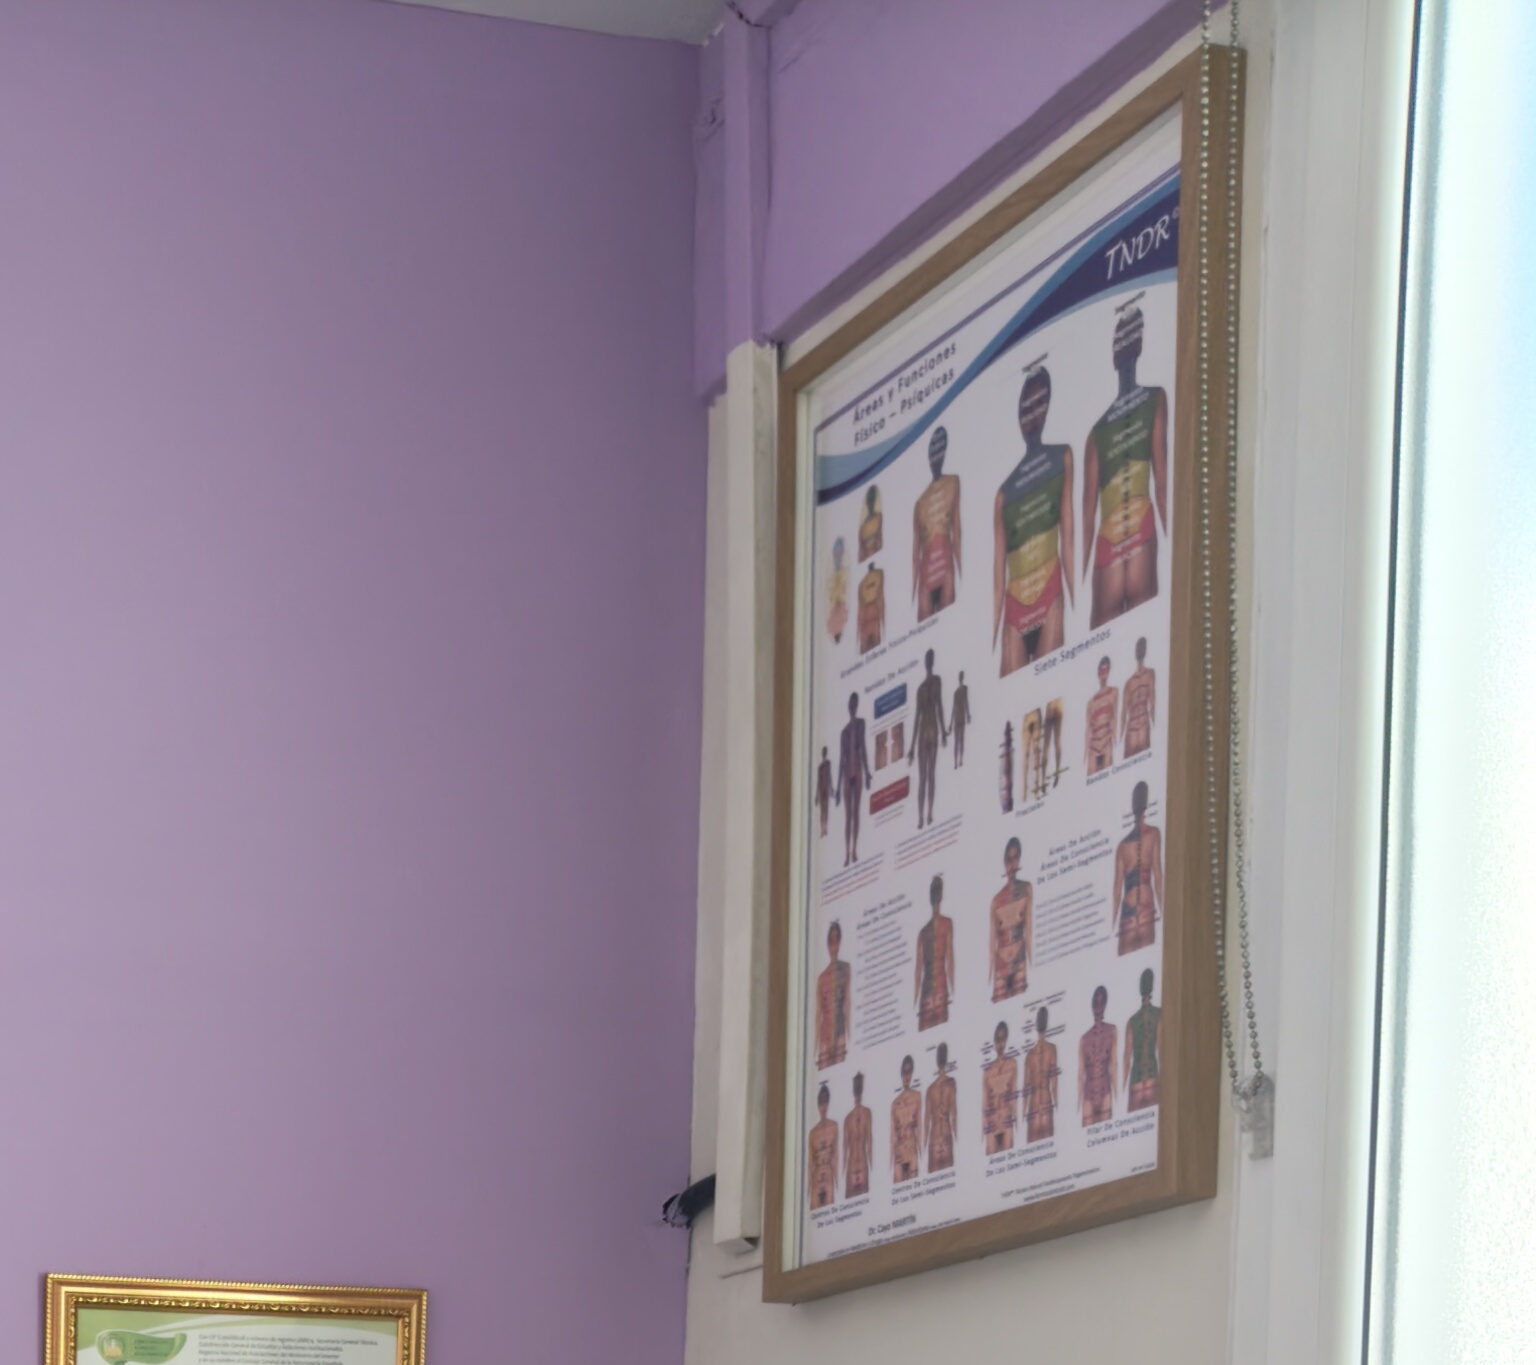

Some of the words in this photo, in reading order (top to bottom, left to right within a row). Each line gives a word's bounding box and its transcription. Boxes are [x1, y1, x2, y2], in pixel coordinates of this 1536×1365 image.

[1105, 215, 1170, 280] TNDR
[853, 395, 883, 425] Áreas
[898, 342, 956, 392] Funciones
[855, 418, 886, 447] Físico
[1034, 657, 1057, 676] Siete
[1060, 629, 1111, 662] Segmentos
